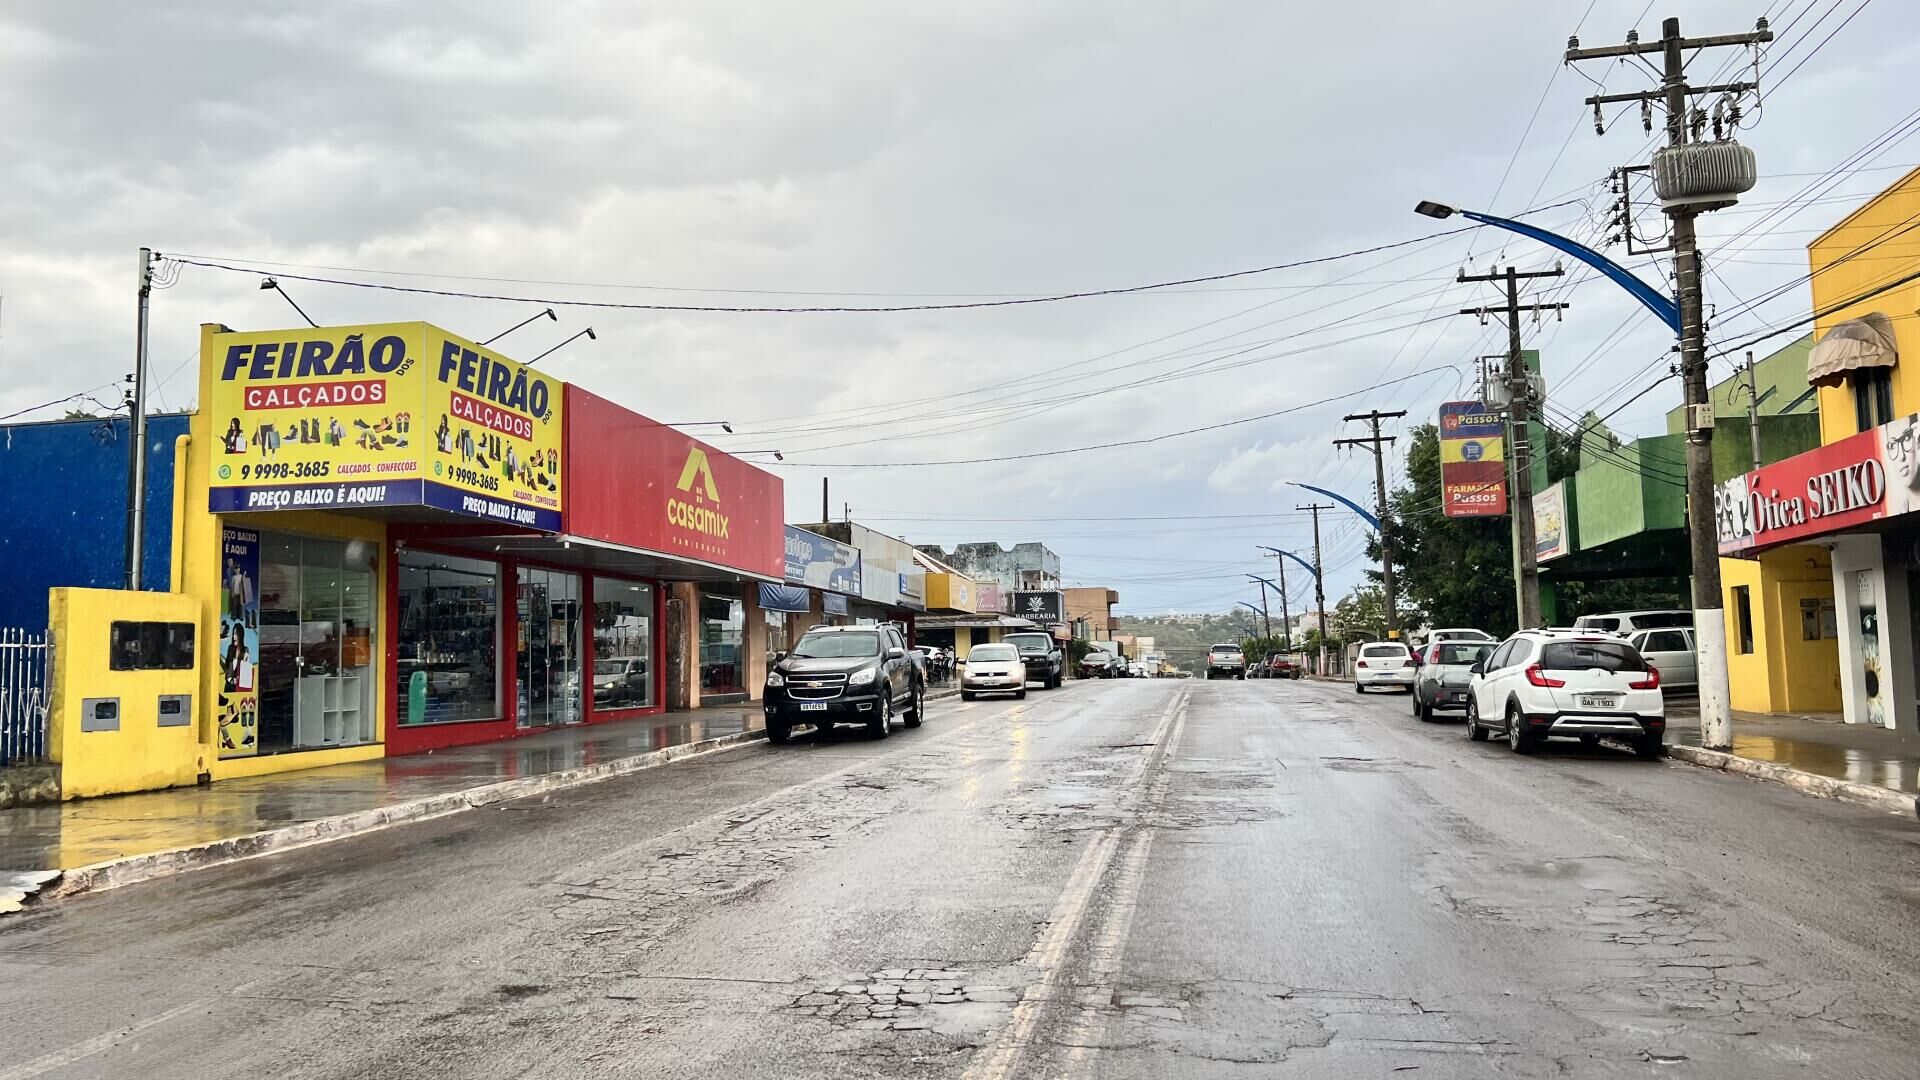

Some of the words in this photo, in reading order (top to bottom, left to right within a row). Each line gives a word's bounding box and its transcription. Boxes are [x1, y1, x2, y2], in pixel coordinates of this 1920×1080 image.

[221, 333, 406, 381] FEIRÃO
[396, 358, 415, 377] DOS
[438, 339, 548, 418] FEIRÃO
[248, 383, 383, 408] CALÇADOS
[452, 396, 532, 439] CALÇADOS
[542, 408, 553, 425] DOS
[1458, 414, 1499, 425] Passos
[241, 464, 251, 480] 9
[254, 461, 330, 480] 9998-3685
[337, 463, 371, 477] CALÇADOS
[448, 465, 454, 480] 9
[456, 467, 499, 492] 9998-3685
[248, 491, 291, 510] PREÇO
[293, 488, 334, 505] BAIXO
[336, 484, 345, 503] É
[347, 485, 387, 504] AQUI!
[1453, 493, 1497, 504] Passos
[1750, 475, 1808, 534] Ótica
[1807, 458, 1887, 520] SEIKO
[462, 496, 487, 517] PREÇO
[488, 501, 510, 519] BAIXO
[511, 503, 516, 520] É
[516, 508, 536, 524] AQUI!
[667, 497, 729, 540] casamix
[237, 531, 257, 543] BAIXO
[230, 544, 247, 556] AQUI
[1015, 613, 1057, 621] BARBEARIA
